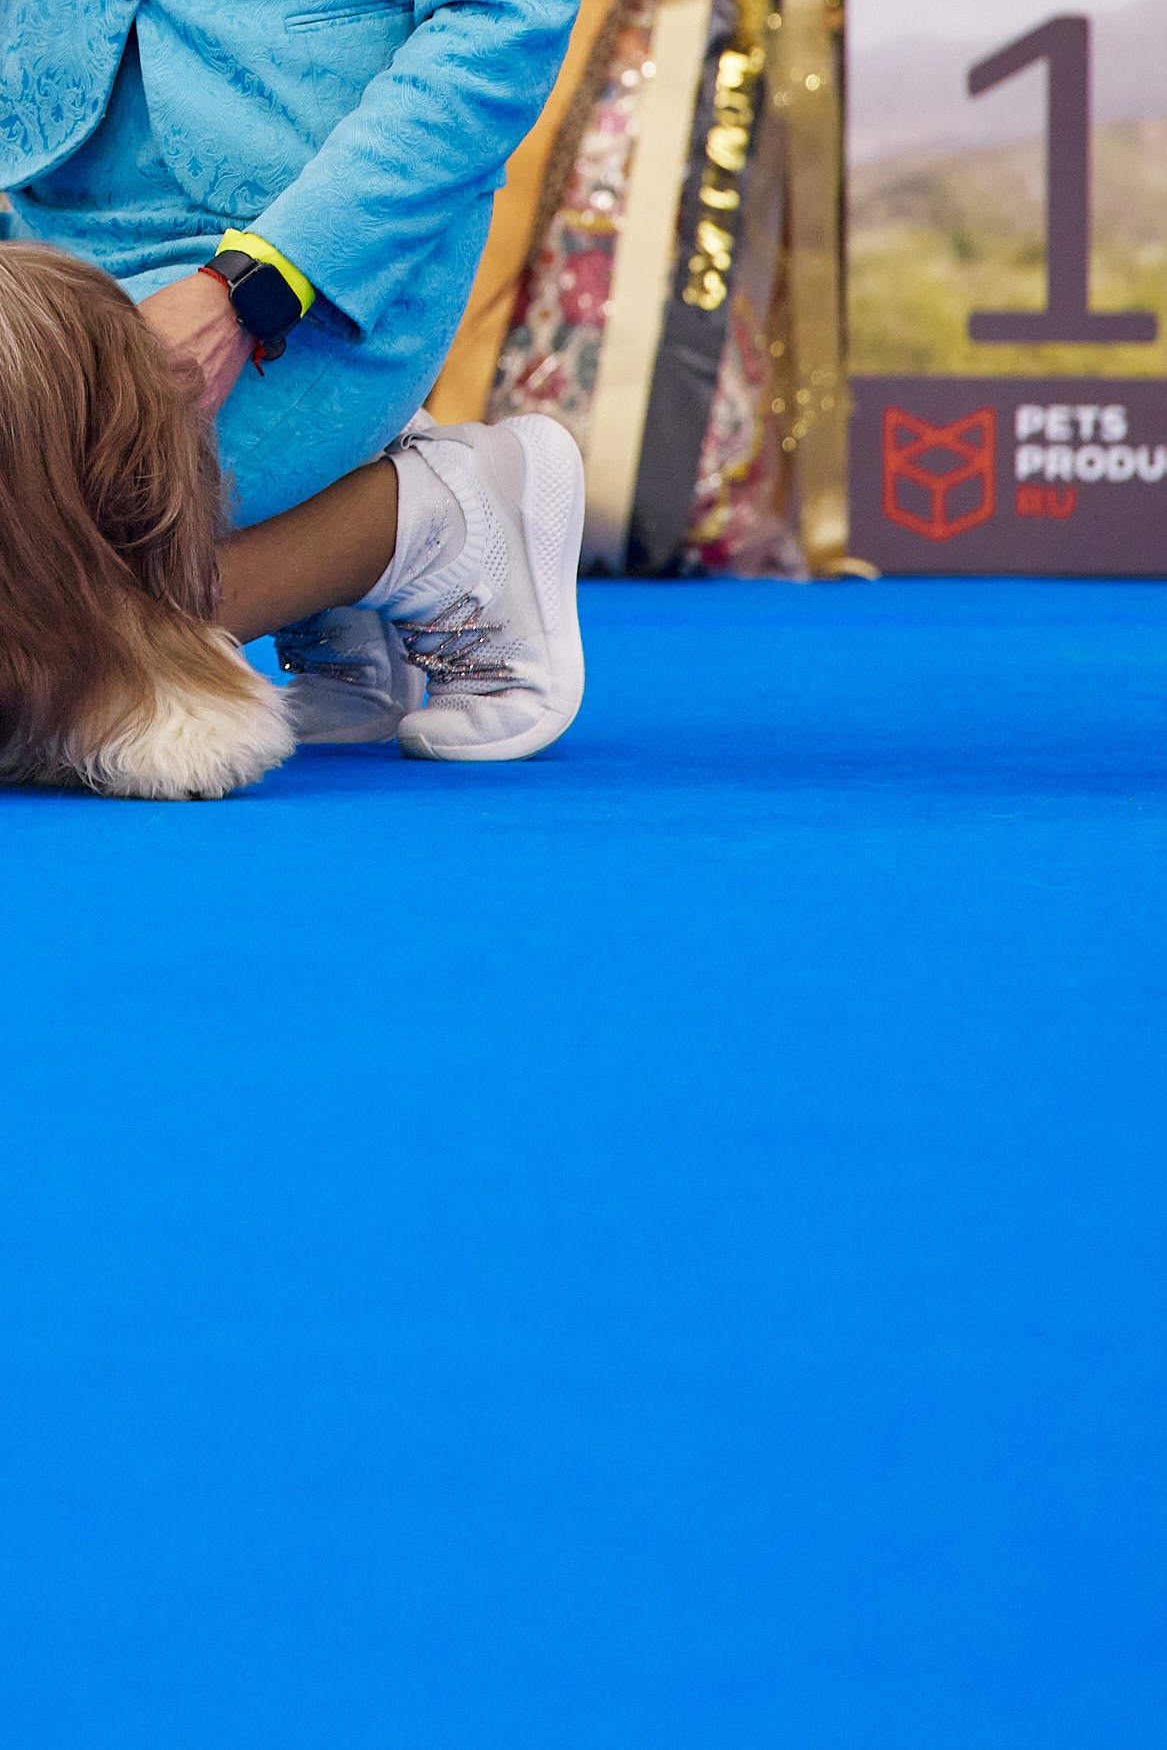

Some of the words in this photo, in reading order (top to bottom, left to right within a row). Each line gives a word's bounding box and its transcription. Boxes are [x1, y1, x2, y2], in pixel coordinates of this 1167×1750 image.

[967, 14, 1158, 344] 1
[1015, 404, 1128, 442] PETS
[1015, 443, 1167, 483] PRODU
[1015, 482, 1077, 520] RU
